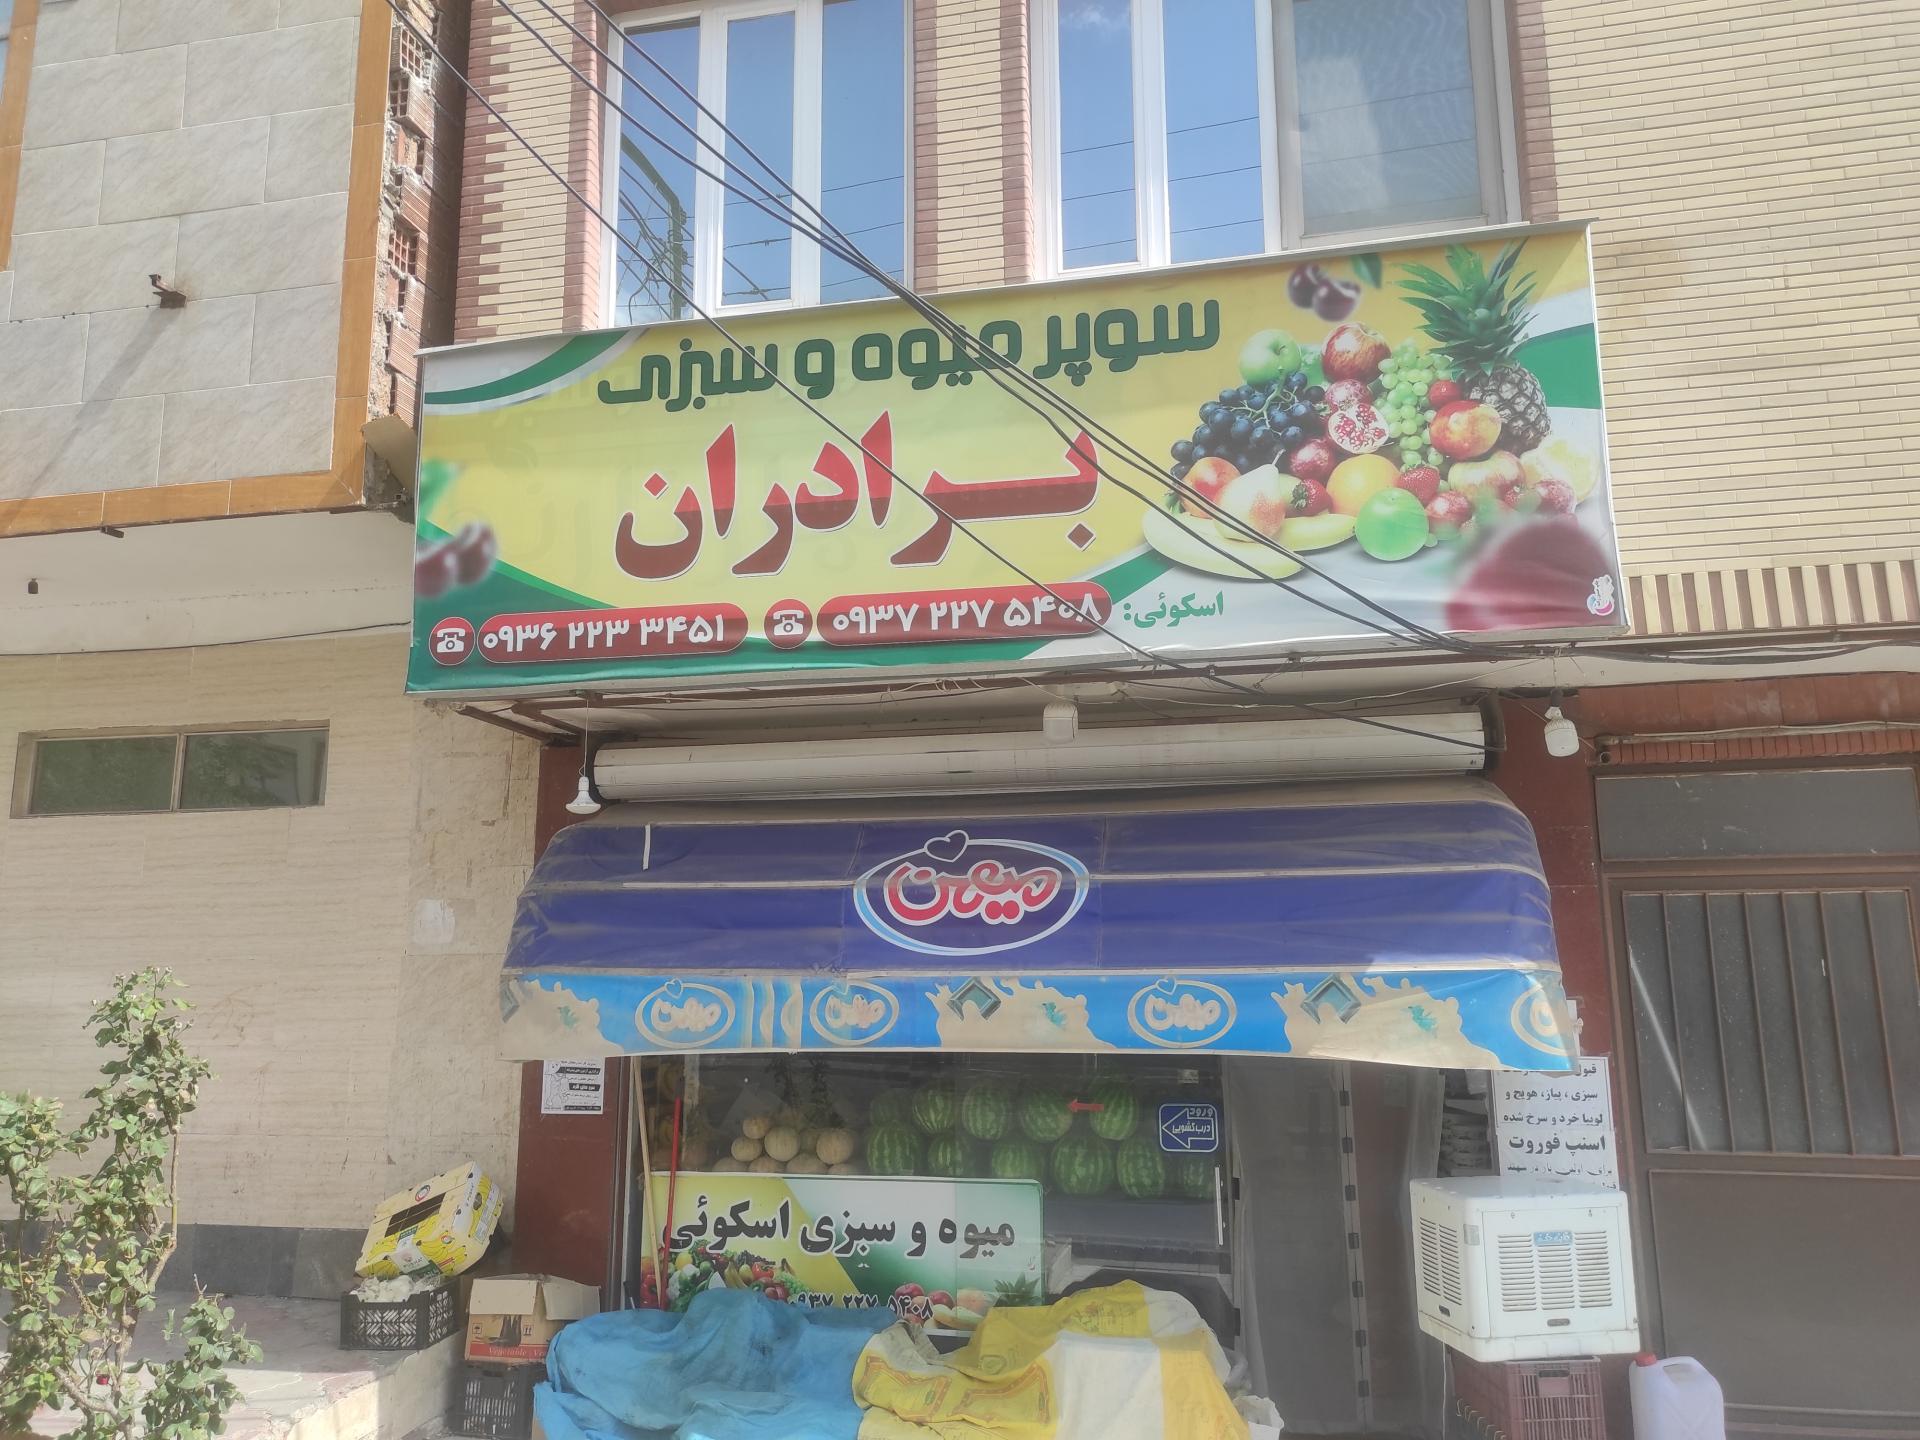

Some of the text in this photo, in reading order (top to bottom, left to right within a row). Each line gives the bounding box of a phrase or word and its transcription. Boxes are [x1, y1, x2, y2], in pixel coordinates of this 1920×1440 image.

[598, 299, 1220, 412] سوپر میوه و سبزی
[615, 410, 1099, 582] برادران
[483, 614, 724, 652] ۰۹۳۶ ۲۲۳ ۳۴۵۱
[833, 603, 920, 634] ۰۹۳۷
[930, 598, 995, 630] ۲۲۷
[884, 860, 1062, 926] میهن
[1509, 1133, 1606, 1156] اسنپ فوروت
[663, 1195, 1016, 1259] میوه و سبزی اسکوئی
